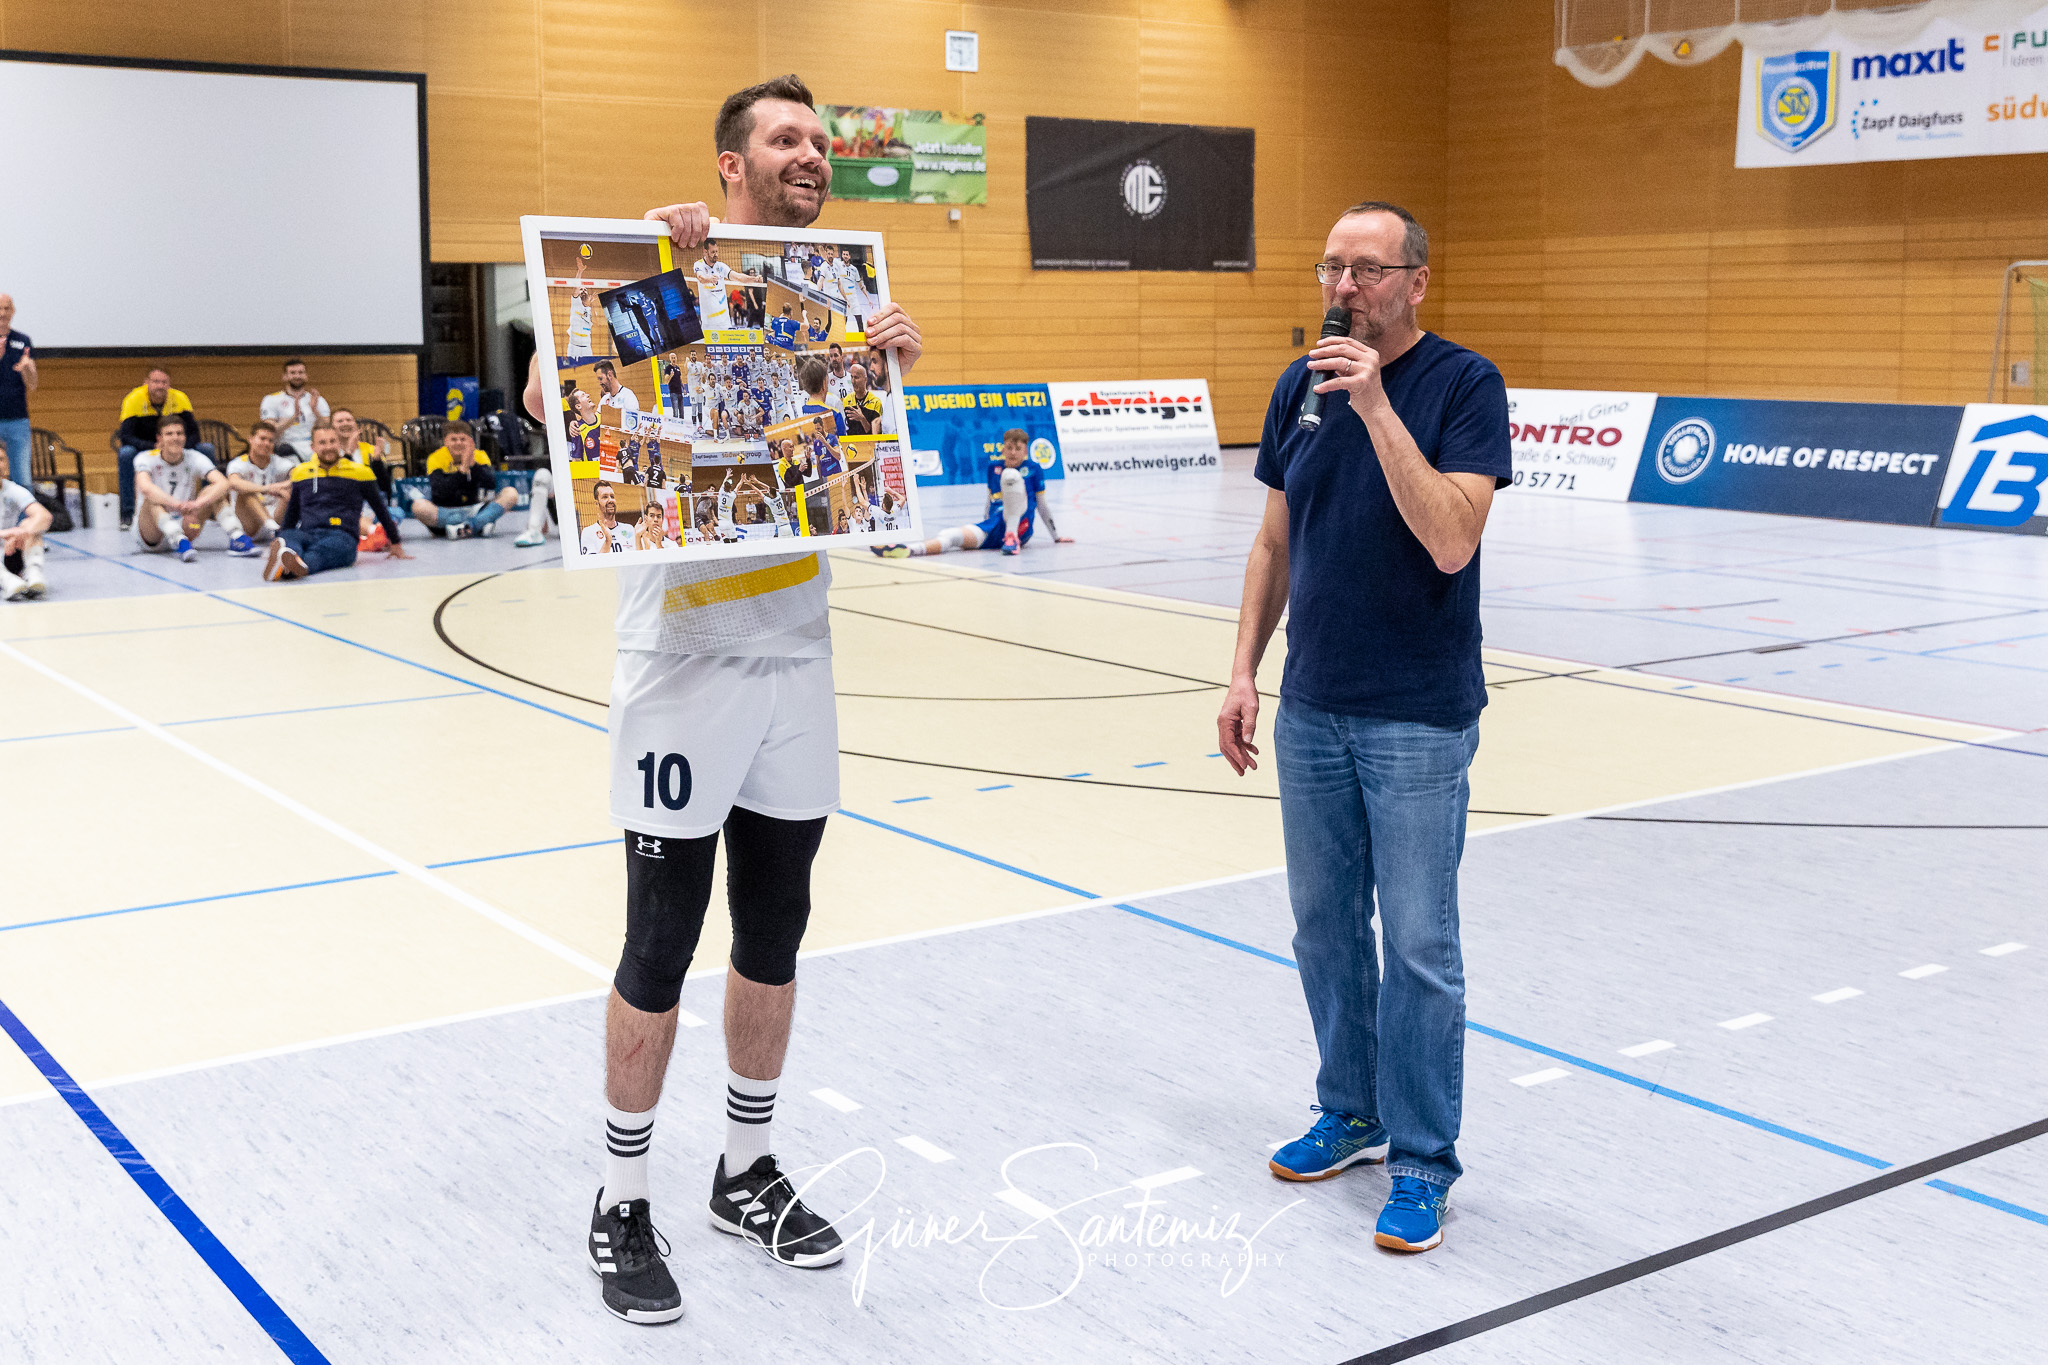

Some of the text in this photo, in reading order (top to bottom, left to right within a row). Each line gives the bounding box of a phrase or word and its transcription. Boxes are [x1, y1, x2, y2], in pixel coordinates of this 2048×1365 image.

[1851, 38, 1965, 81] maxit
[1862, 111, 1963, 131] Zapf Daigfuss
[839, 388, 847, 398] 10
[923, 393, 976, 413] JUGEND
[979, 393, 1003, 408] EIN
[1005, 391, 1047, 407] NETZ!
[1060, 391, 1202, 419] schweiger
[1588, 401, 1629, 420] Gino
[641, 415, 662, 424] maxit
[1068, 454, 1216, 473] www.schweiger.de
[1564, 450, 1617, 470] Schwaig
[1722, 443, 1939, 476] HOME OF RESPECT
[653, 471, 659, 480] 2
[1513, 470, 1576, 490] 0 57 71
[885, 522, 892, 530] 10
[611, 542, 622, 553] 10
[637, 751, 692, 810] 10
